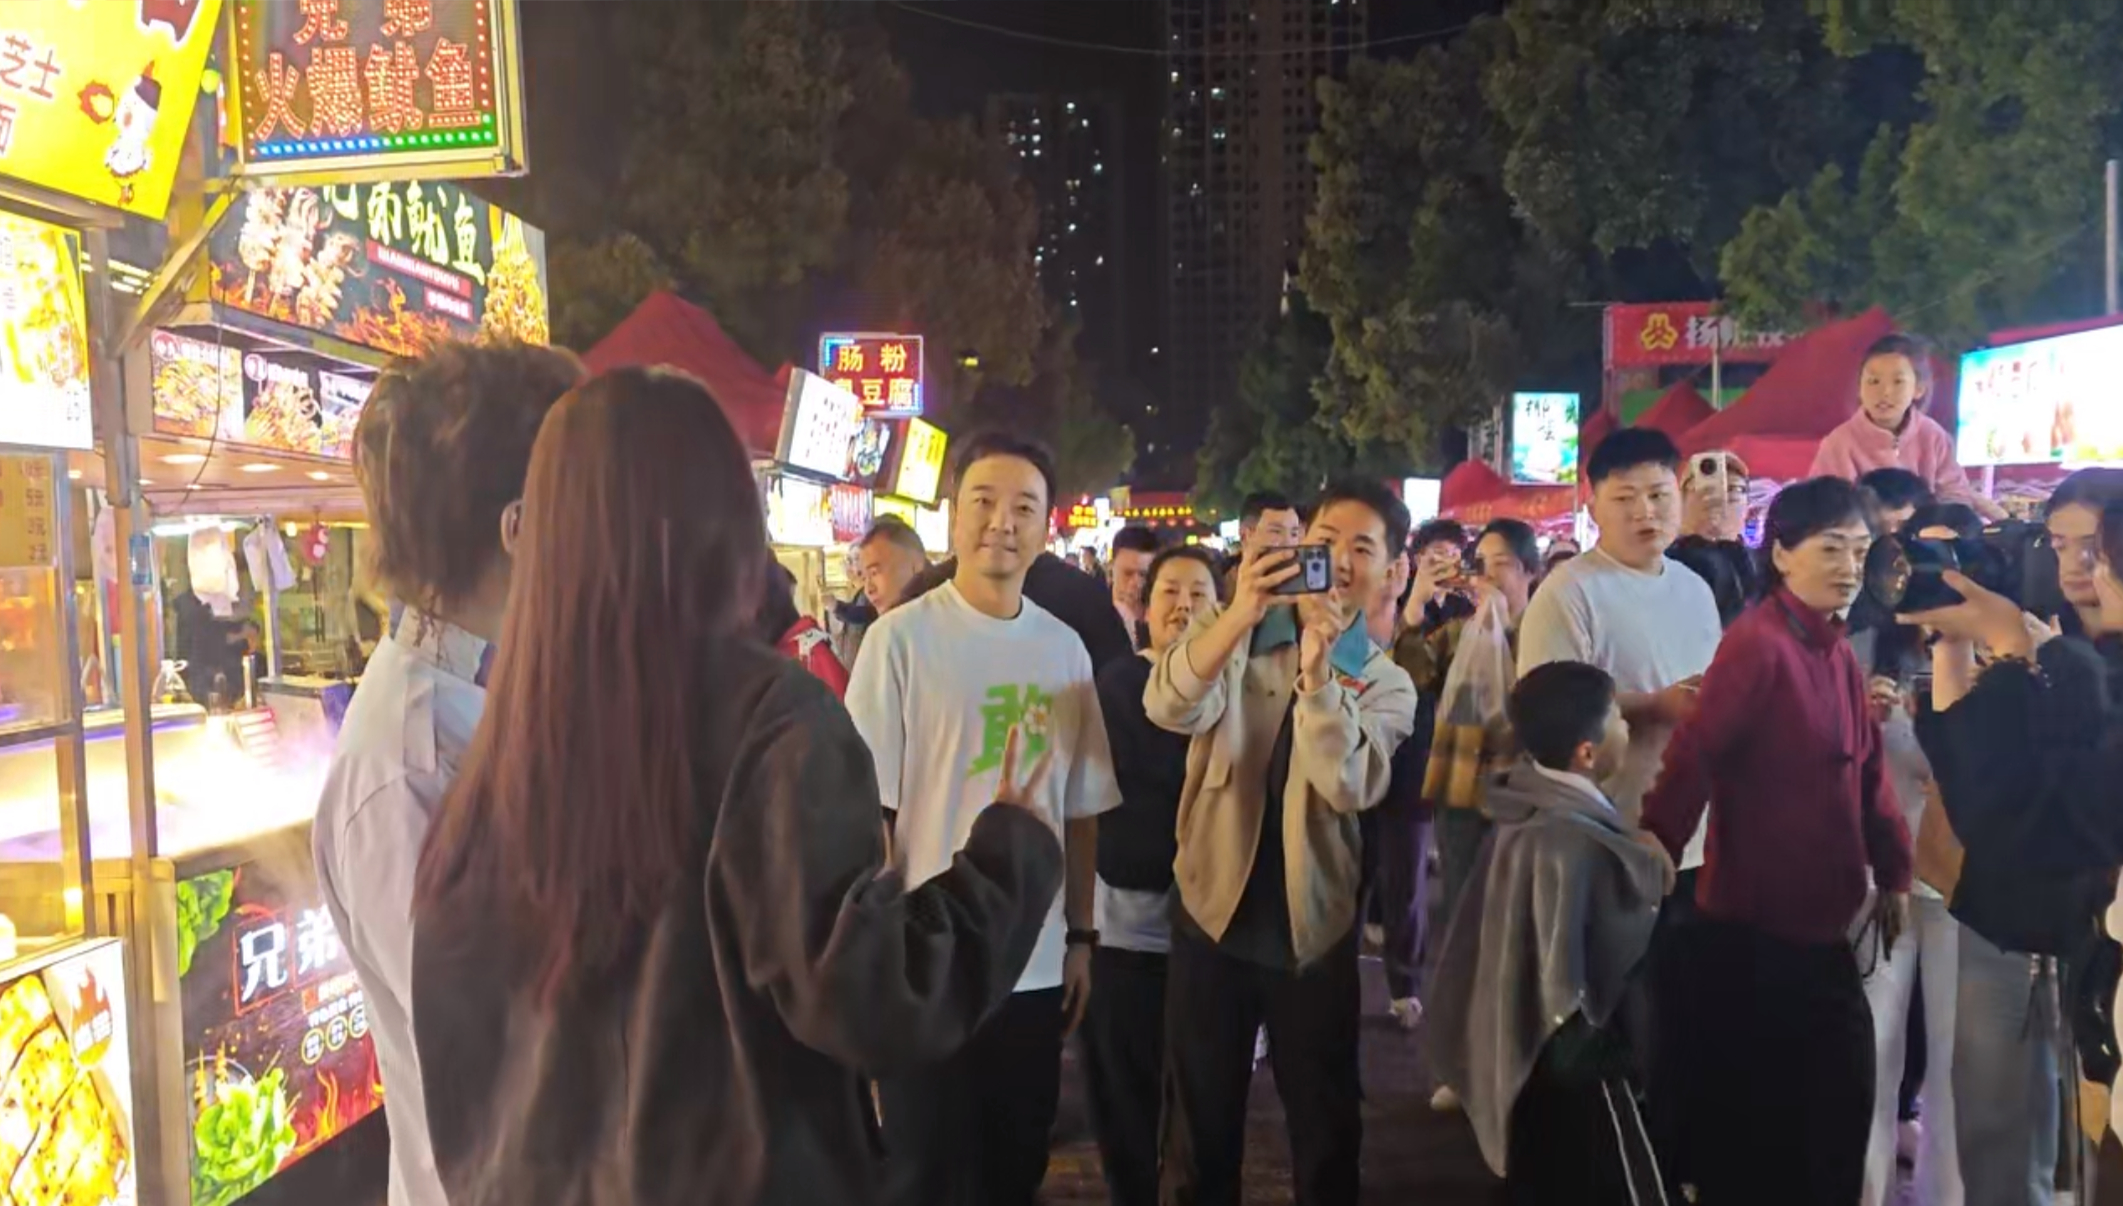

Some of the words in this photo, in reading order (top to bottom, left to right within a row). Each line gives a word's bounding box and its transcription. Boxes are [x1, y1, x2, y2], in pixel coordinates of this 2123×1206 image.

[0, 35, 61, 99] 芝士
[255, 37, 480, 141] 火爆鱿鱼
[837, 344, 907, 372] 肠粉
